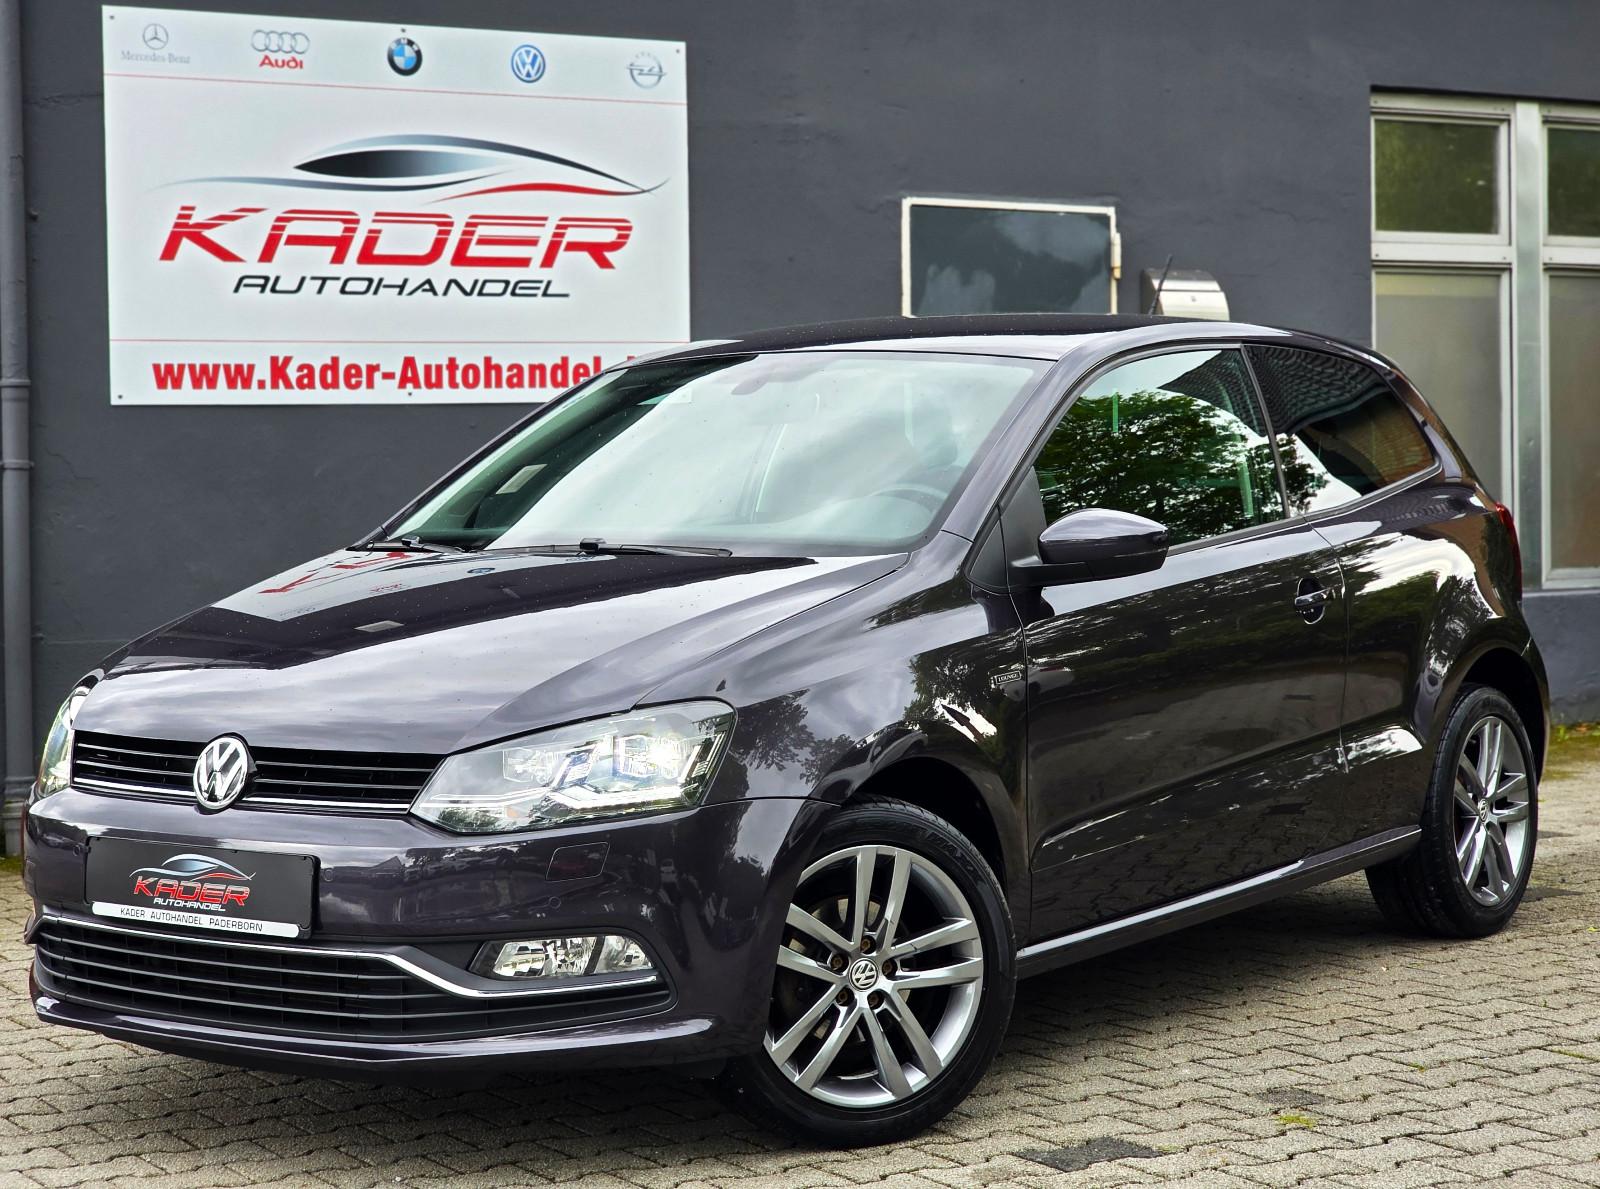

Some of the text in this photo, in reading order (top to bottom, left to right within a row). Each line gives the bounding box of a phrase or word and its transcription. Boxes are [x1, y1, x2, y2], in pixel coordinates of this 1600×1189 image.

[258, 54, 304, 69] Audi
[159, 205, 633, 270] KADER
[233, 274, 570, 298] AUTOHANDEL
[133, 875, 251, 906] KADER
[153, 897, 226, 912] AUTOHANDEL
[120, 907, 263, 932] KADER AUTOHANDEL PADERBORN
